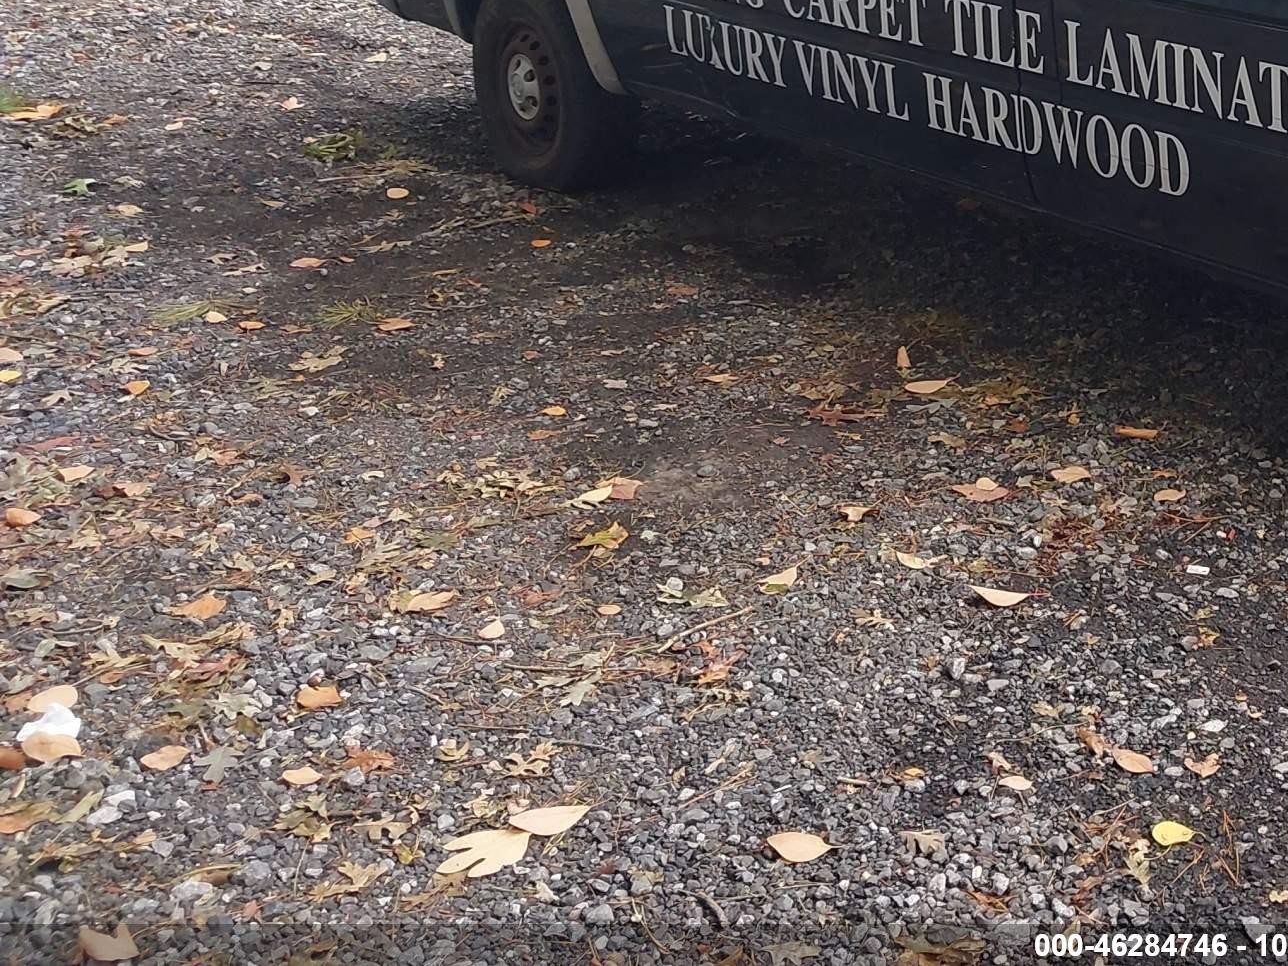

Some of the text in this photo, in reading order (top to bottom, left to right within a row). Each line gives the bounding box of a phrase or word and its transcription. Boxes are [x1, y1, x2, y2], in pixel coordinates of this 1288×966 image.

[662, 4, 1191, 197] LUXURY VINYL HARDWOOD
